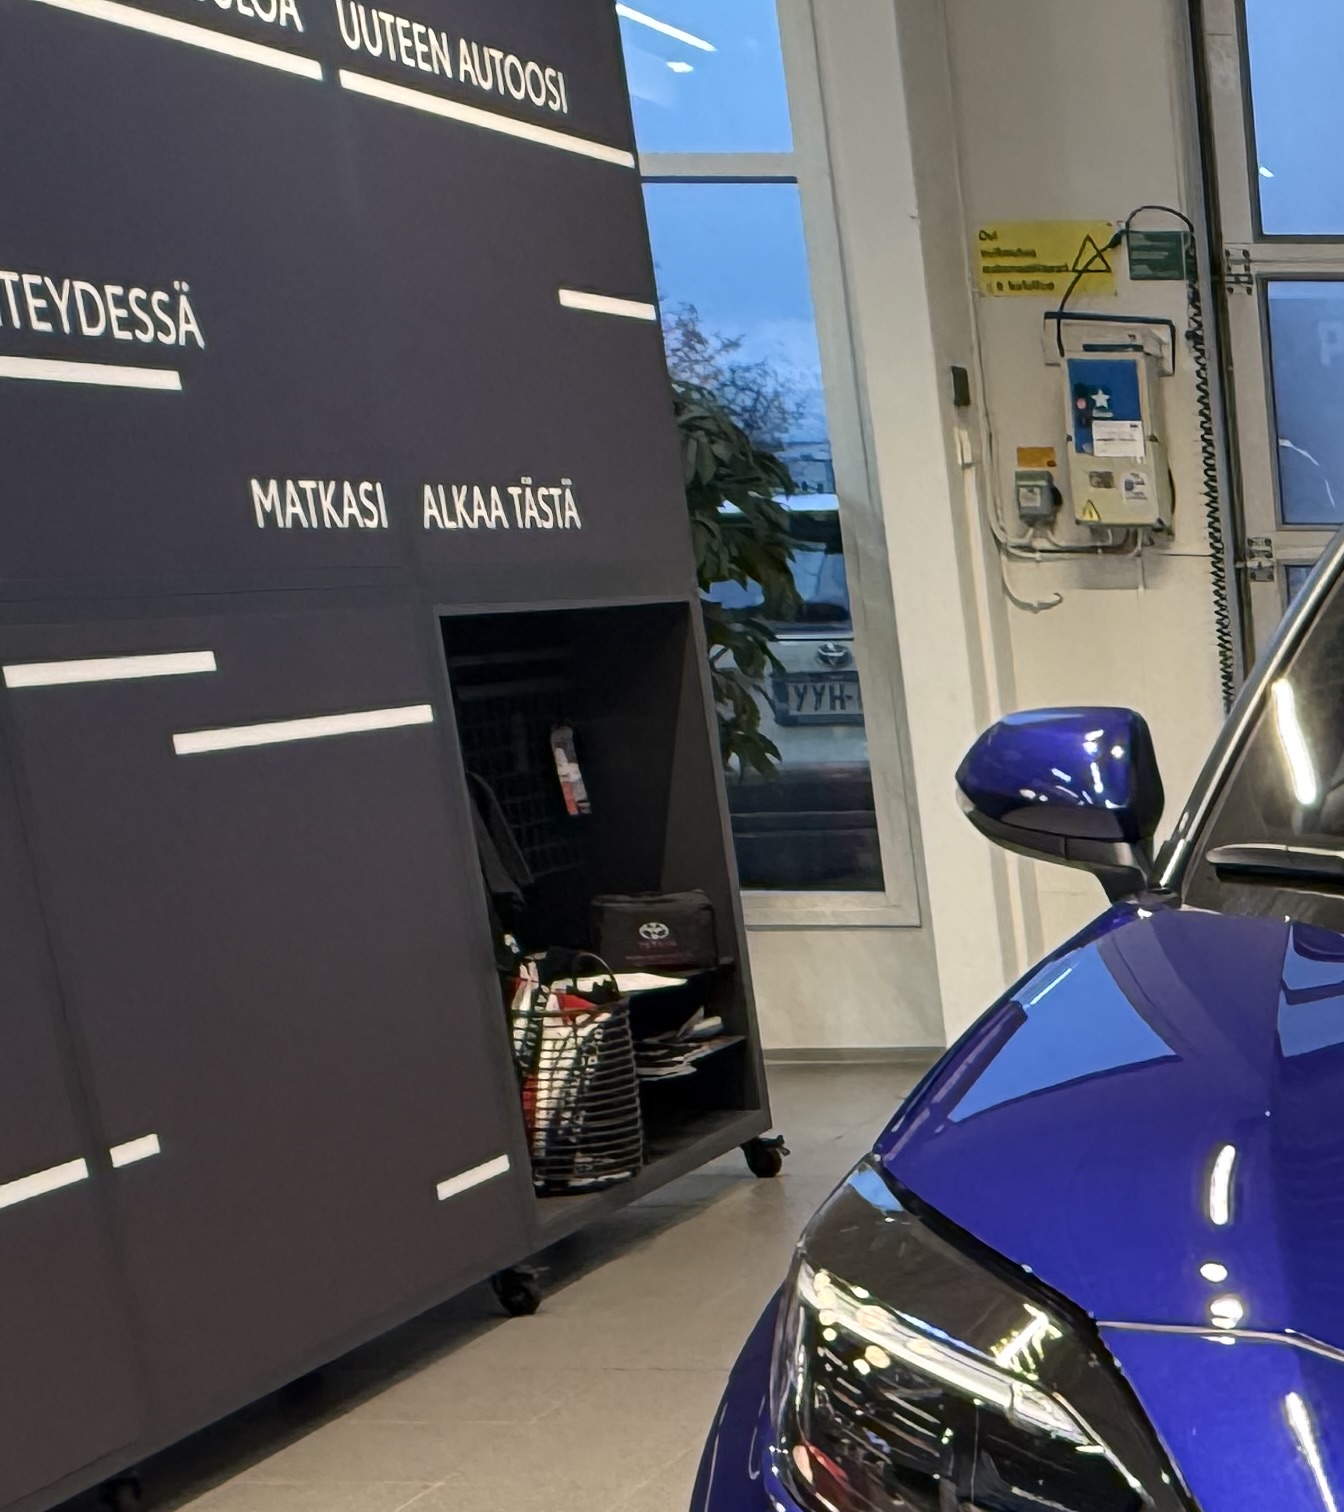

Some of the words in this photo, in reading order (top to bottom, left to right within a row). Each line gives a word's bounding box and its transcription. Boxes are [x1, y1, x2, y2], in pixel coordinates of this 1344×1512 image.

[335, 0, 452, 78] UUTEEN
[459, 38, 568, 114] AUTOOSI
[0, 271, 206, 349] TEYDESSÄ
[250, 479, 388, 529] MATKASI
[423, 484, 510, 529] ALKAA
[507, 477, 582, 529] TÄSTÄ
